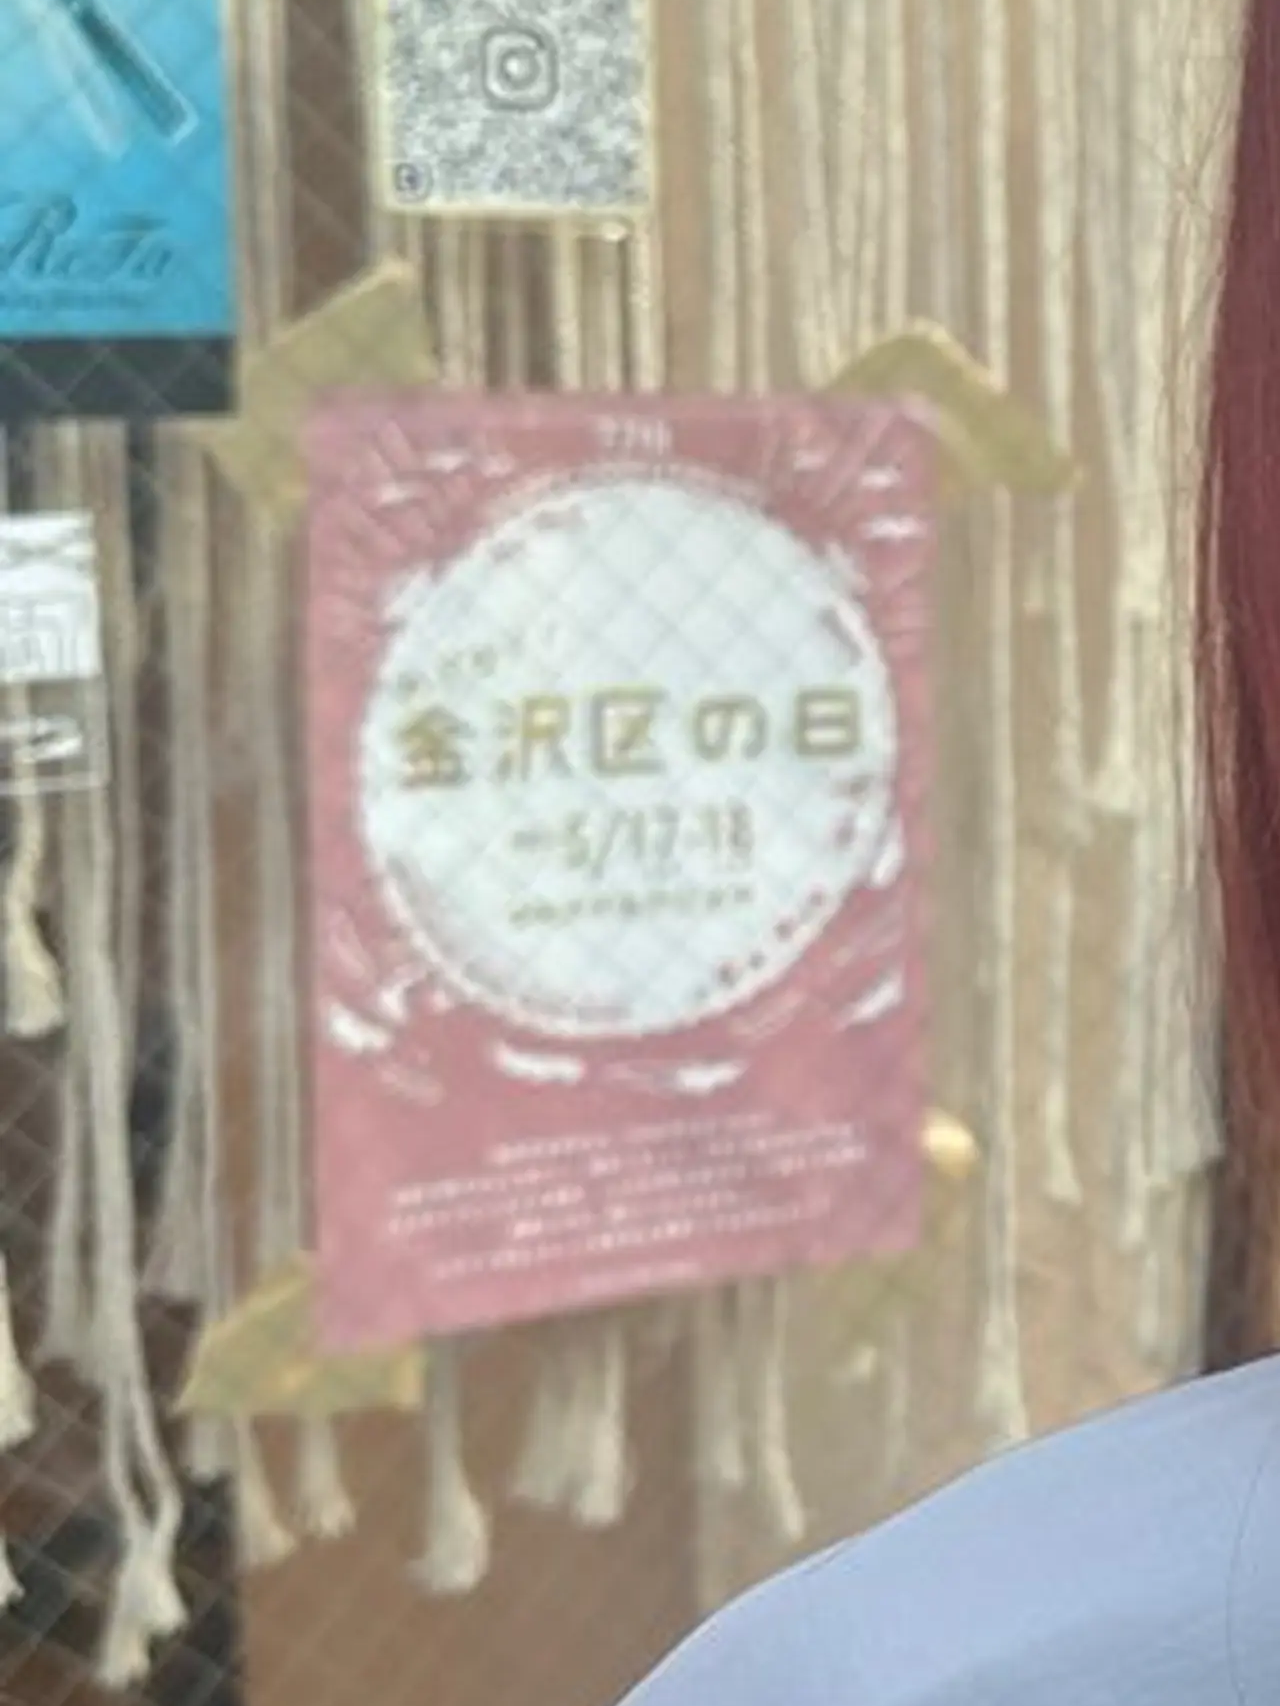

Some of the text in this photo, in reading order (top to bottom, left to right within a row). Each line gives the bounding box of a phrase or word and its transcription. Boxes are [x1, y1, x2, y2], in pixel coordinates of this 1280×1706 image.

[395, 683, 862, 790] 金沢区の日
